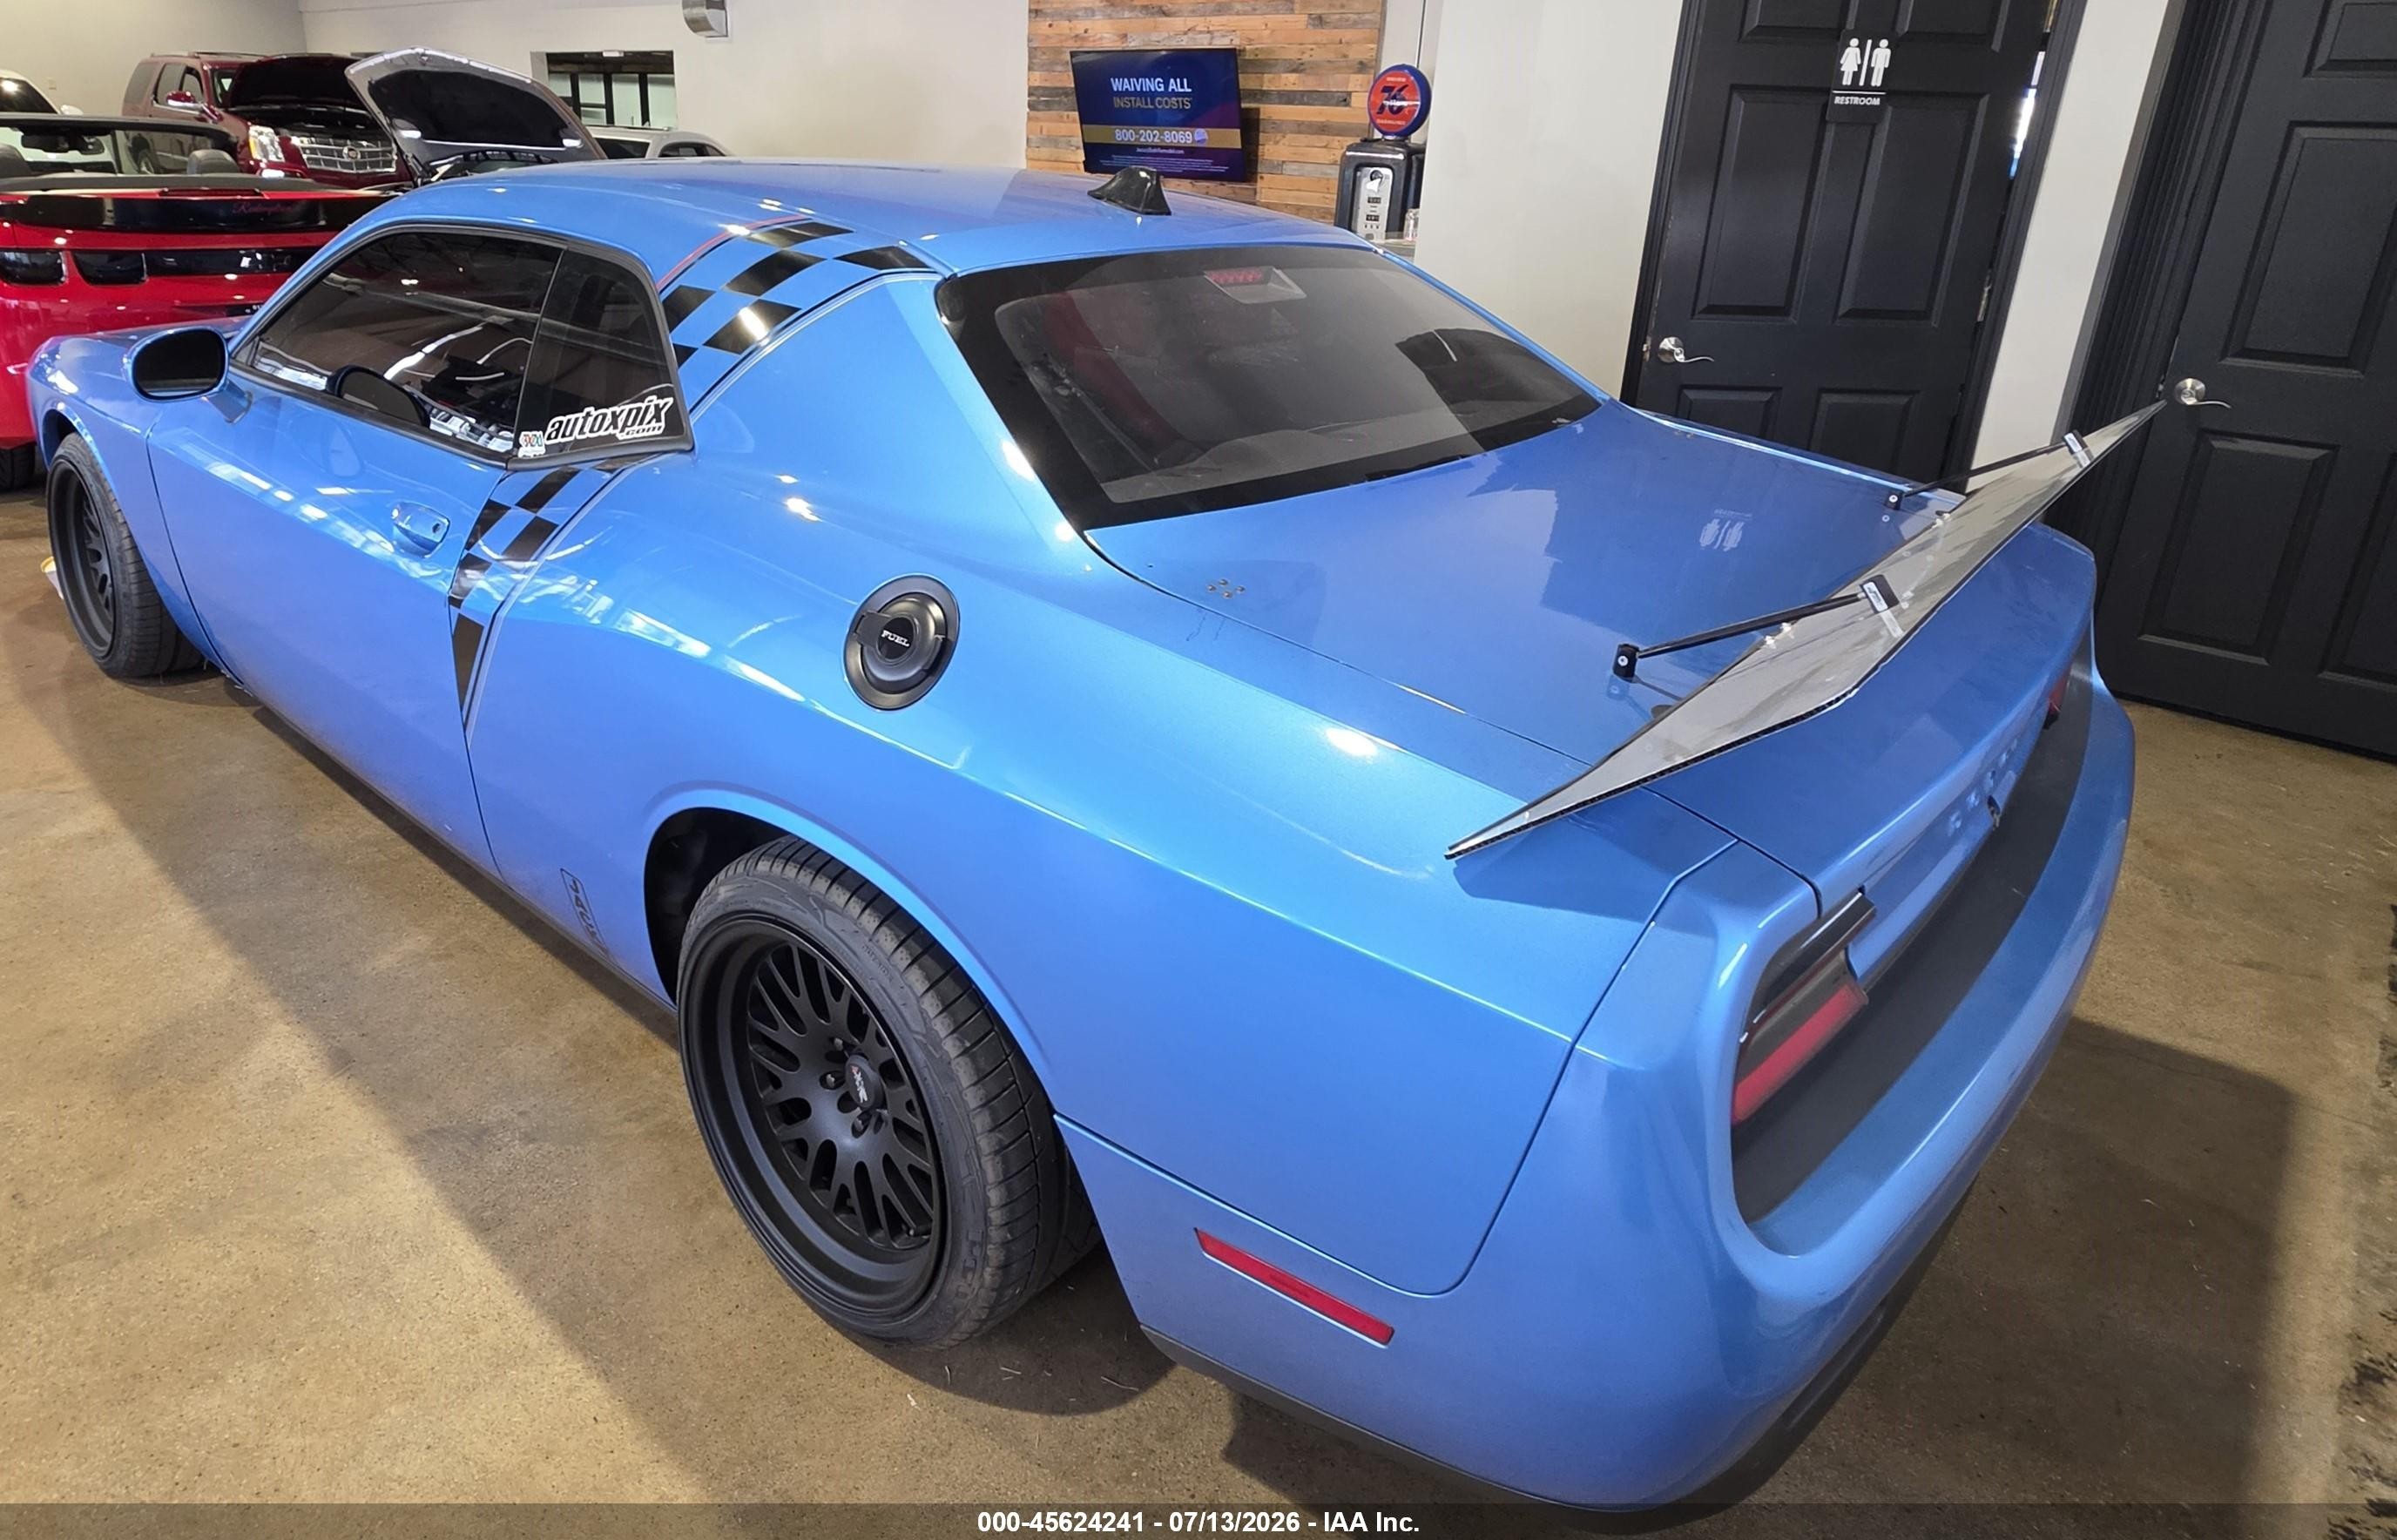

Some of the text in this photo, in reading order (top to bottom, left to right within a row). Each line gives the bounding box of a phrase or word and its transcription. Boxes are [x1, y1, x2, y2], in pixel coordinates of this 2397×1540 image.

[1111, 78, 1192, 92] WAIVING ALL
[1113, 97, 1154, 109] INSTALL
[1376, 84, 1408, 115] 76
[1834, 96, 1880, 105] RESTROOM
[1115, 129, 1193, 144] 800-202-8069
[544, 395, 673, 442] autoxpix
[881, 630, 910, 647] FUEL
